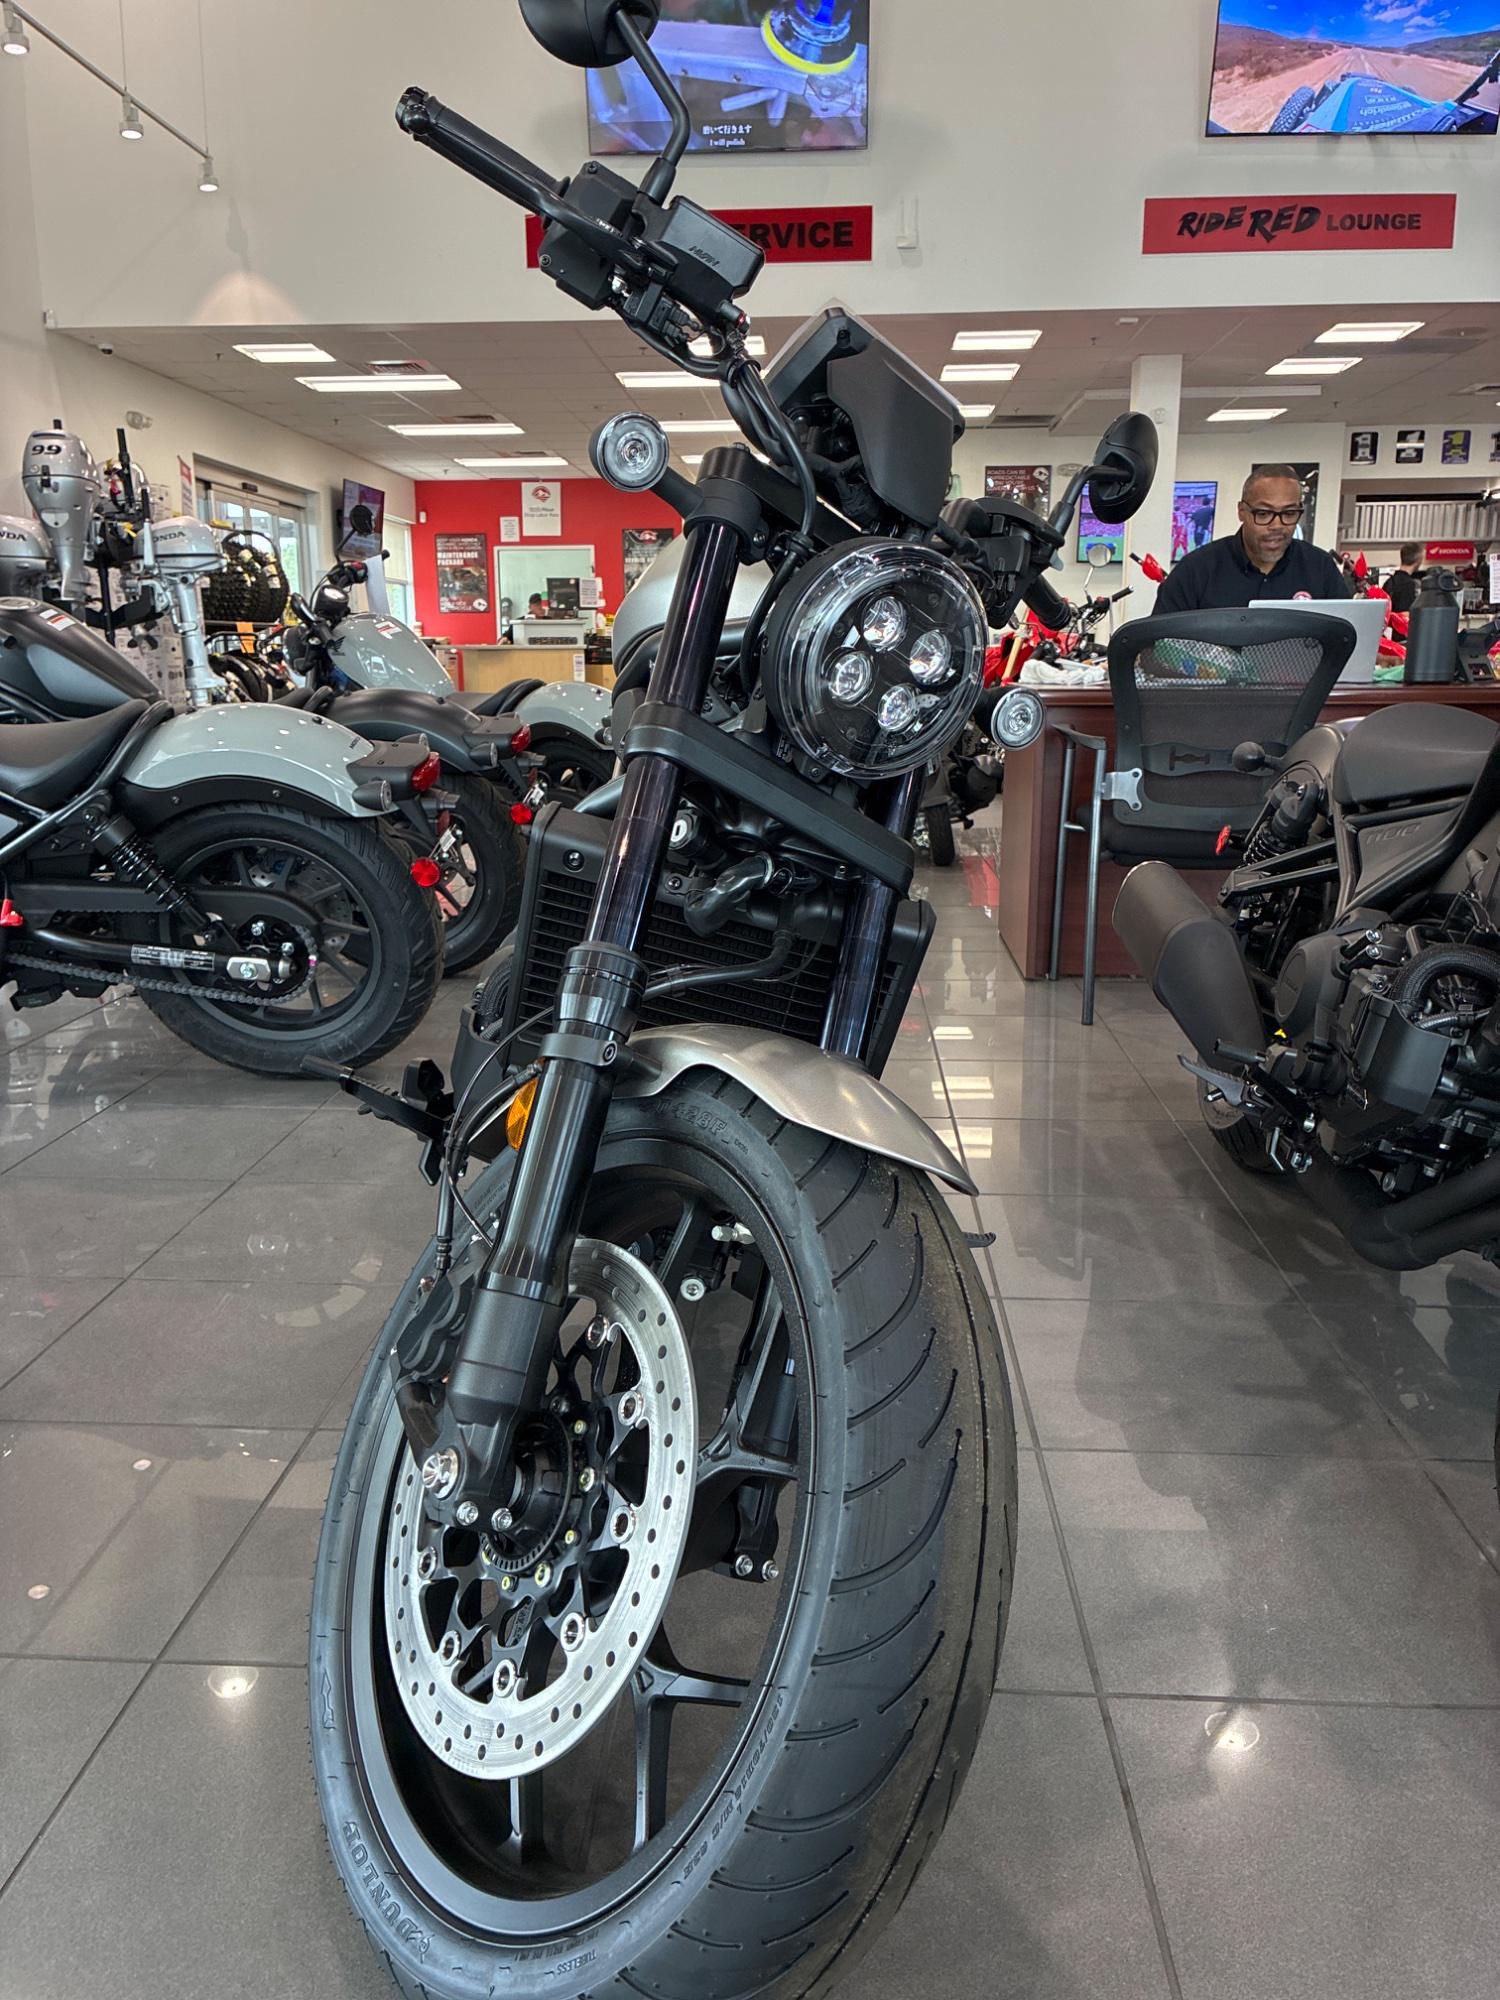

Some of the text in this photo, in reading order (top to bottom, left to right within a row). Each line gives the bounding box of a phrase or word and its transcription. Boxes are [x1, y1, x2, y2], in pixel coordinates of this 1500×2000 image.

[1177, 203, 1421, 243] RIDE RED LOUNGE
[152, 531, 186, 543] ONDA
[343, 1821, 418, 1942] DUNLOP
[556, 1949, 597, 1975] TUBELESS
